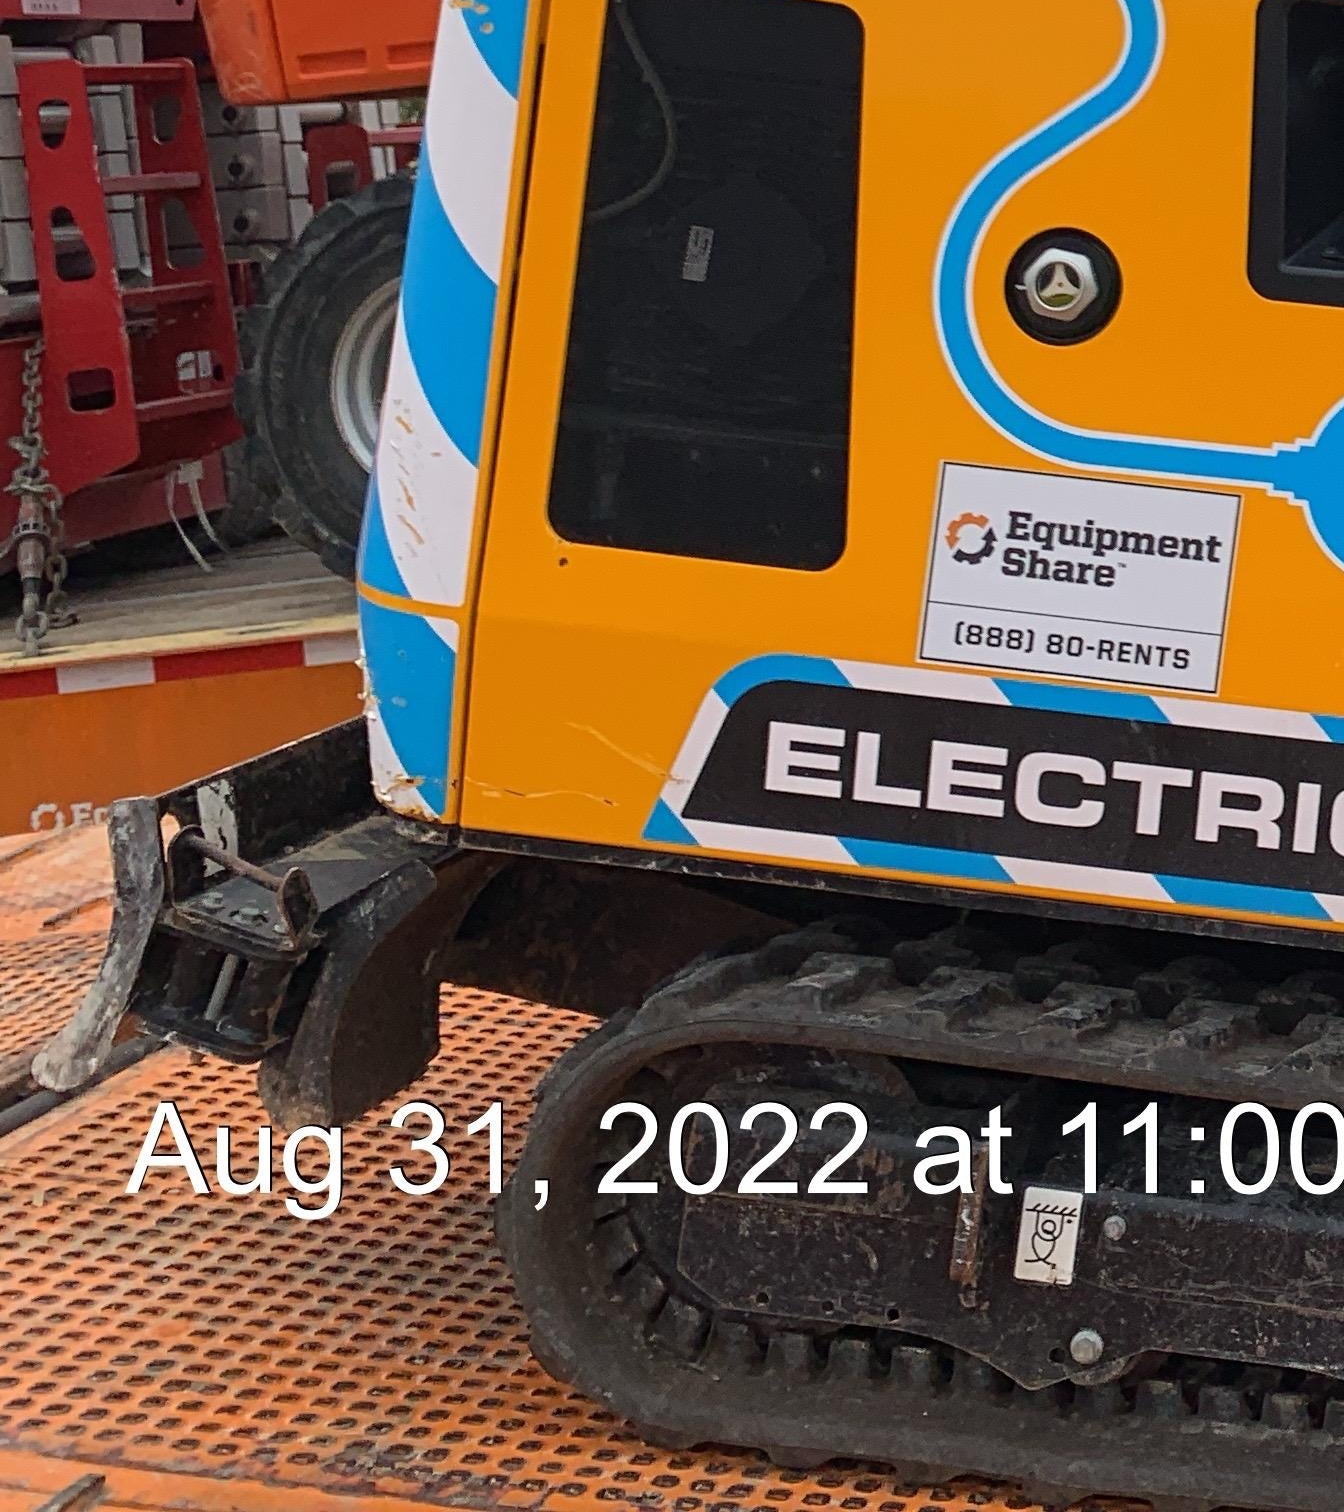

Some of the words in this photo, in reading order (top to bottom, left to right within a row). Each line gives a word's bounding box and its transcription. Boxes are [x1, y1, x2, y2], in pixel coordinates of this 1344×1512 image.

[1006, 510, 1223, 563] Equipment
[954, 620, 1035, 653] (888)
[1046, 633, 1191, 670] 80-RENTS
